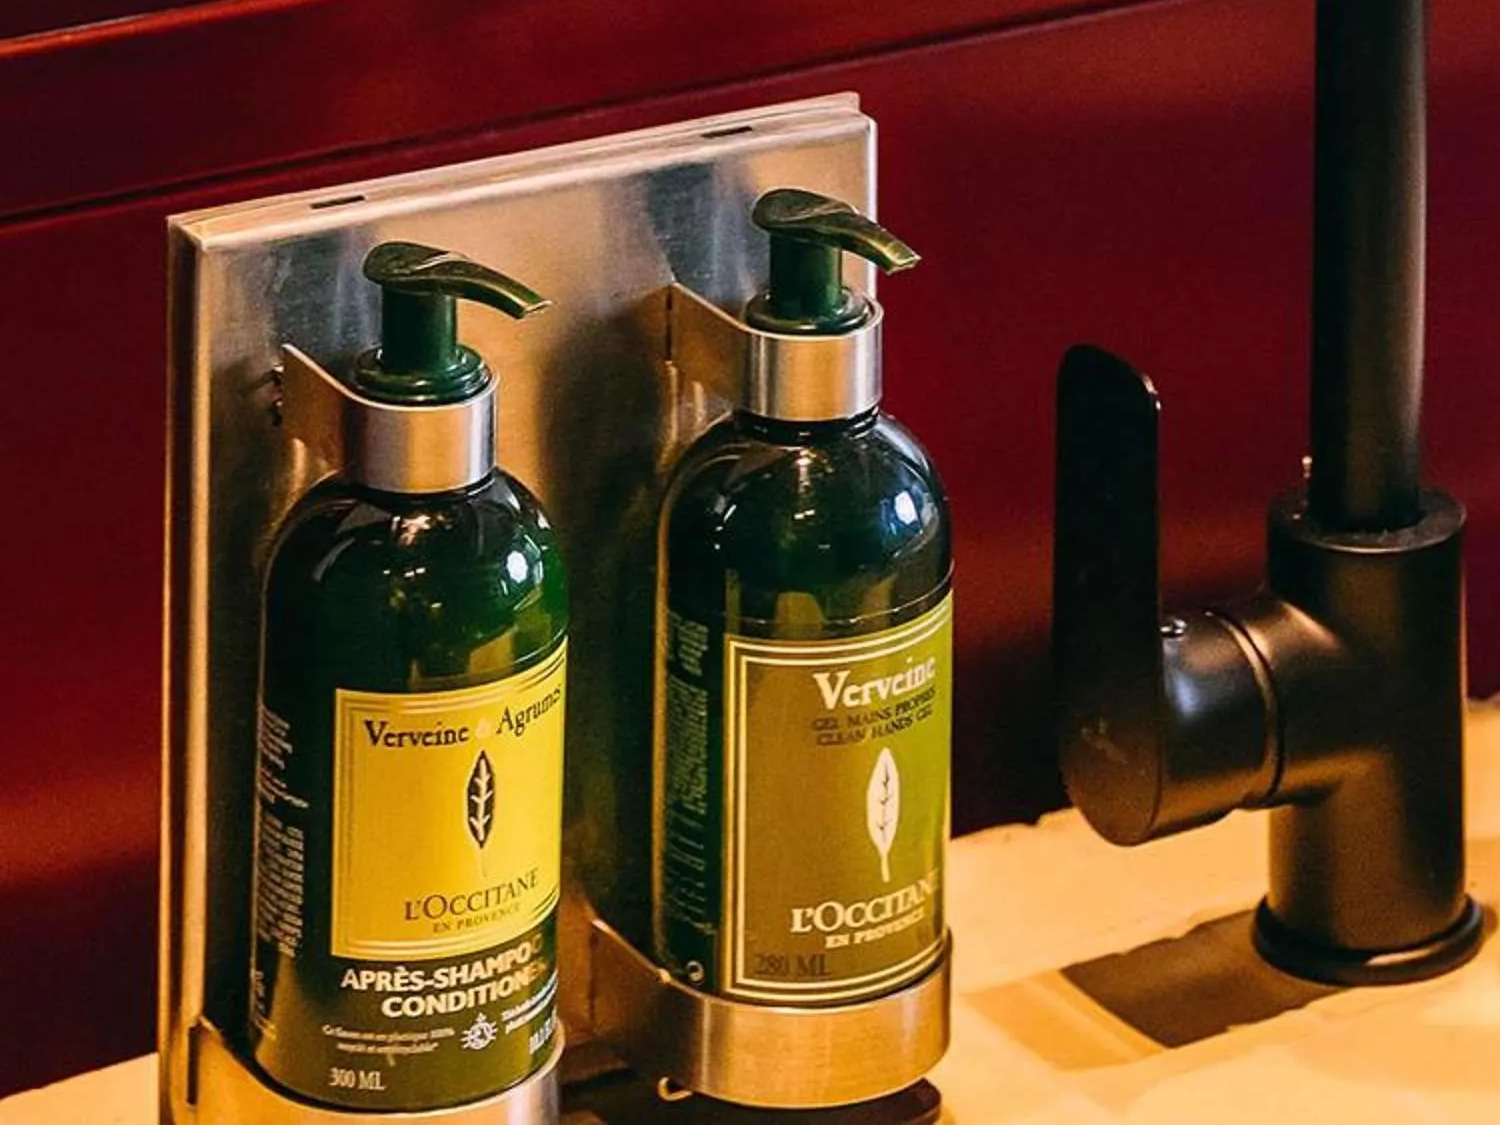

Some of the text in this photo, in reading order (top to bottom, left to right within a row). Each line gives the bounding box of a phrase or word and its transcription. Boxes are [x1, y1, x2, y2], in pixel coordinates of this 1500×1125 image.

[812, 656, 936, 710] Verveine
[848, 707, 891, 728] MAINS
[871, 717, 913, 739] HANDS
[364, 719, 470, 748] Verveine
[404, 867, 539, 921] L'OCCITANE
[790, 867, 939, 933] L'OCCITAN
[433, 903, 520, 934] EN PROVENCE
[825, 934, 850, 949] EN
[798, 953, 832, 976] ML
[328, 1066, 387, 1091] 300 ML
